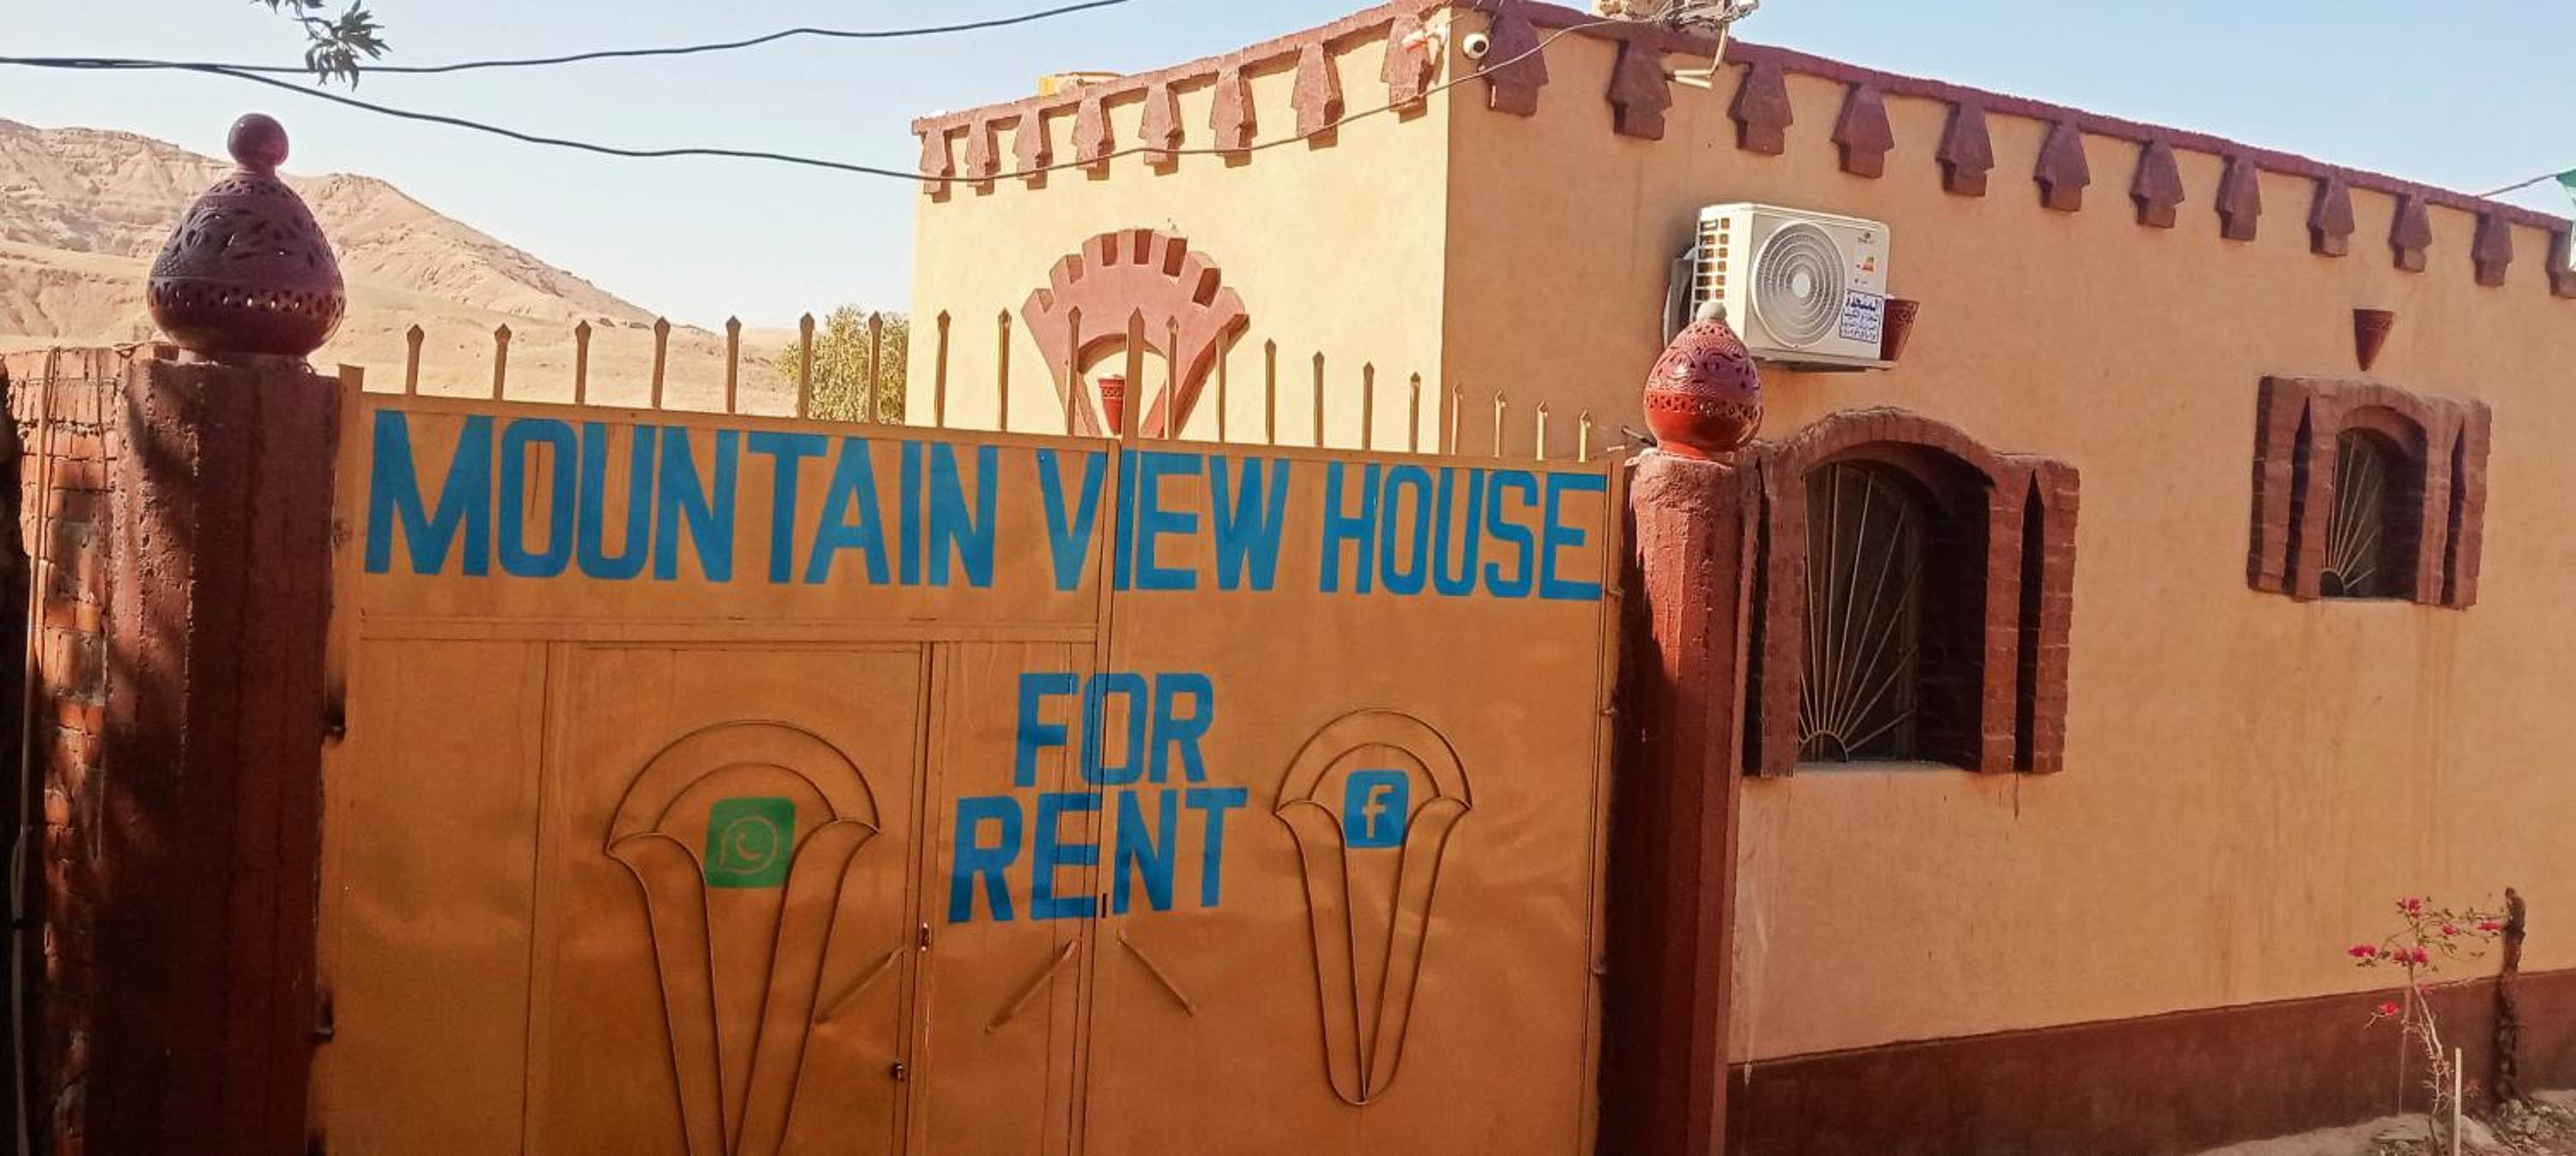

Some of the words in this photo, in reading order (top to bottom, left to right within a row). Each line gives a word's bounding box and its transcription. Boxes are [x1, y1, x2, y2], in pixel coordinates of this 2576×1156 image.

[364, 410, 999, 588] MOUNTAIN
[1037, 447, 1288, 592] VIEW
[1319, 460, 1607, 601] HOUSE
[1014, 672, 1214, 788] FOR
[948, 788, 1249, 924] RENT
